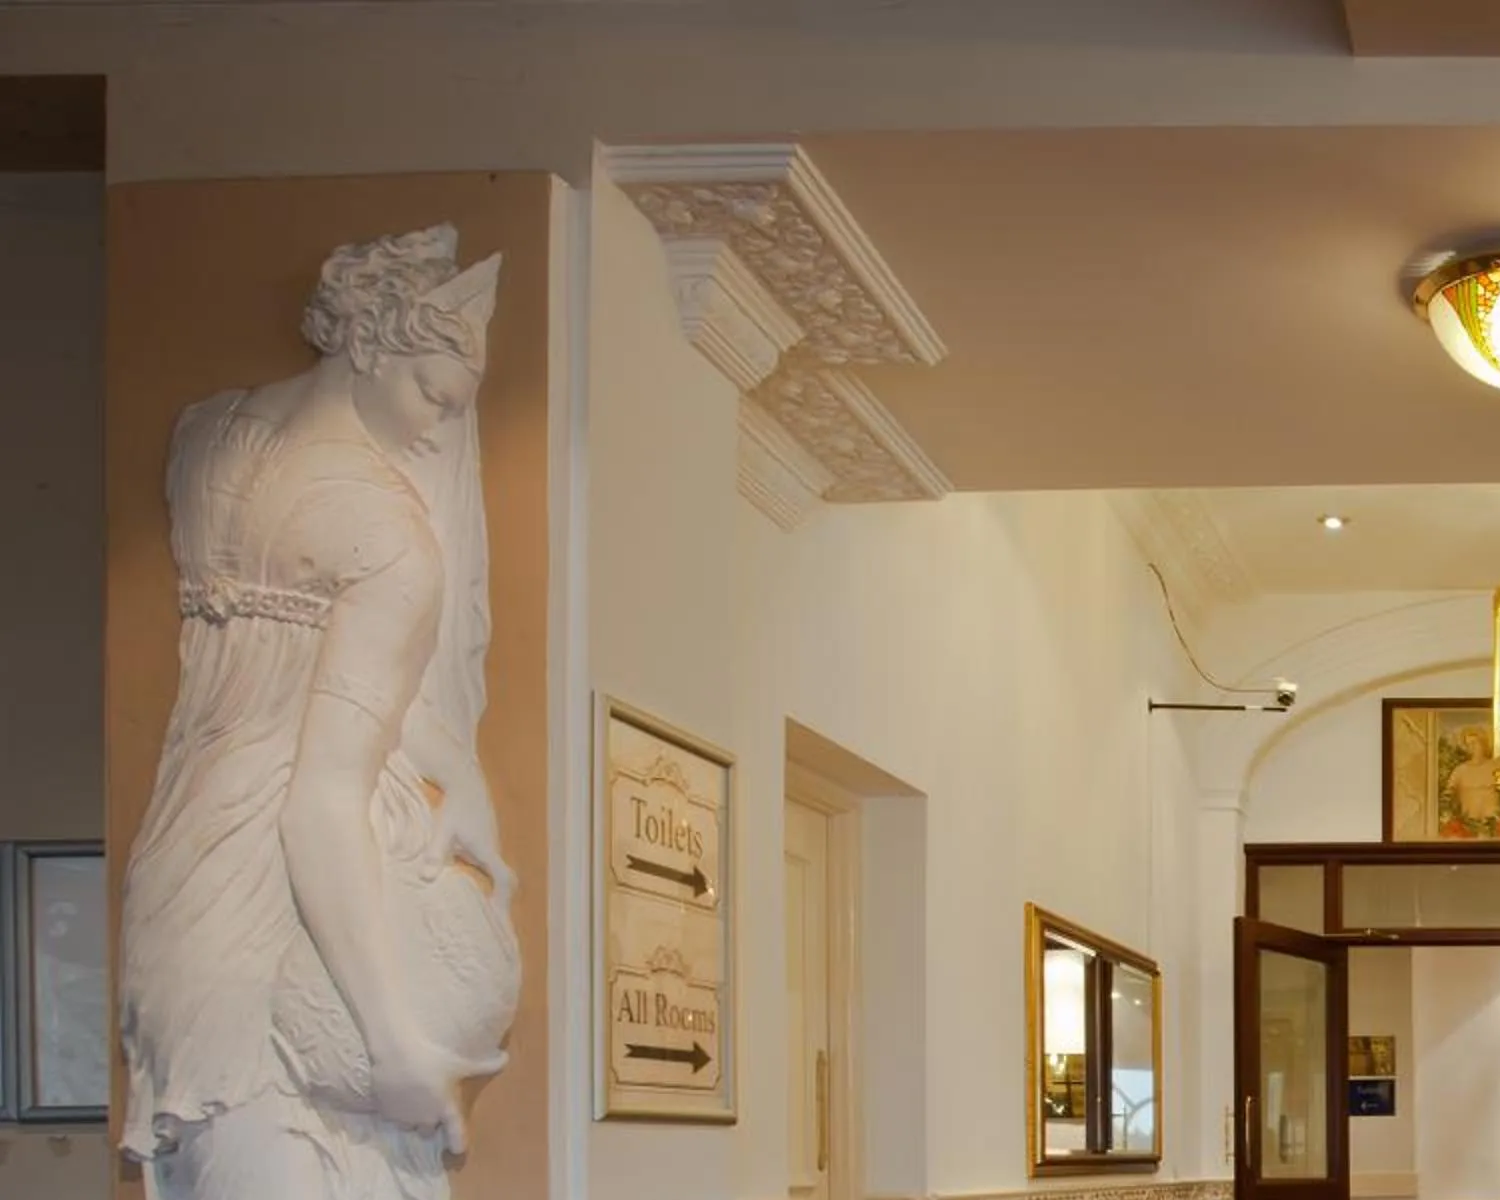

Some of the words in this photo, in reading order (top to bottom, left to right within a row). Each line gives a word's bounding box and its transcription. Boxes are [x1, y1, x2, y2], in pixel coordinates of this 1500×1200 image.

[630, 795, 703, 860] Toilets
[617, 989, 648, 1024] All
[655, 992, 715, 1034] Rooms
